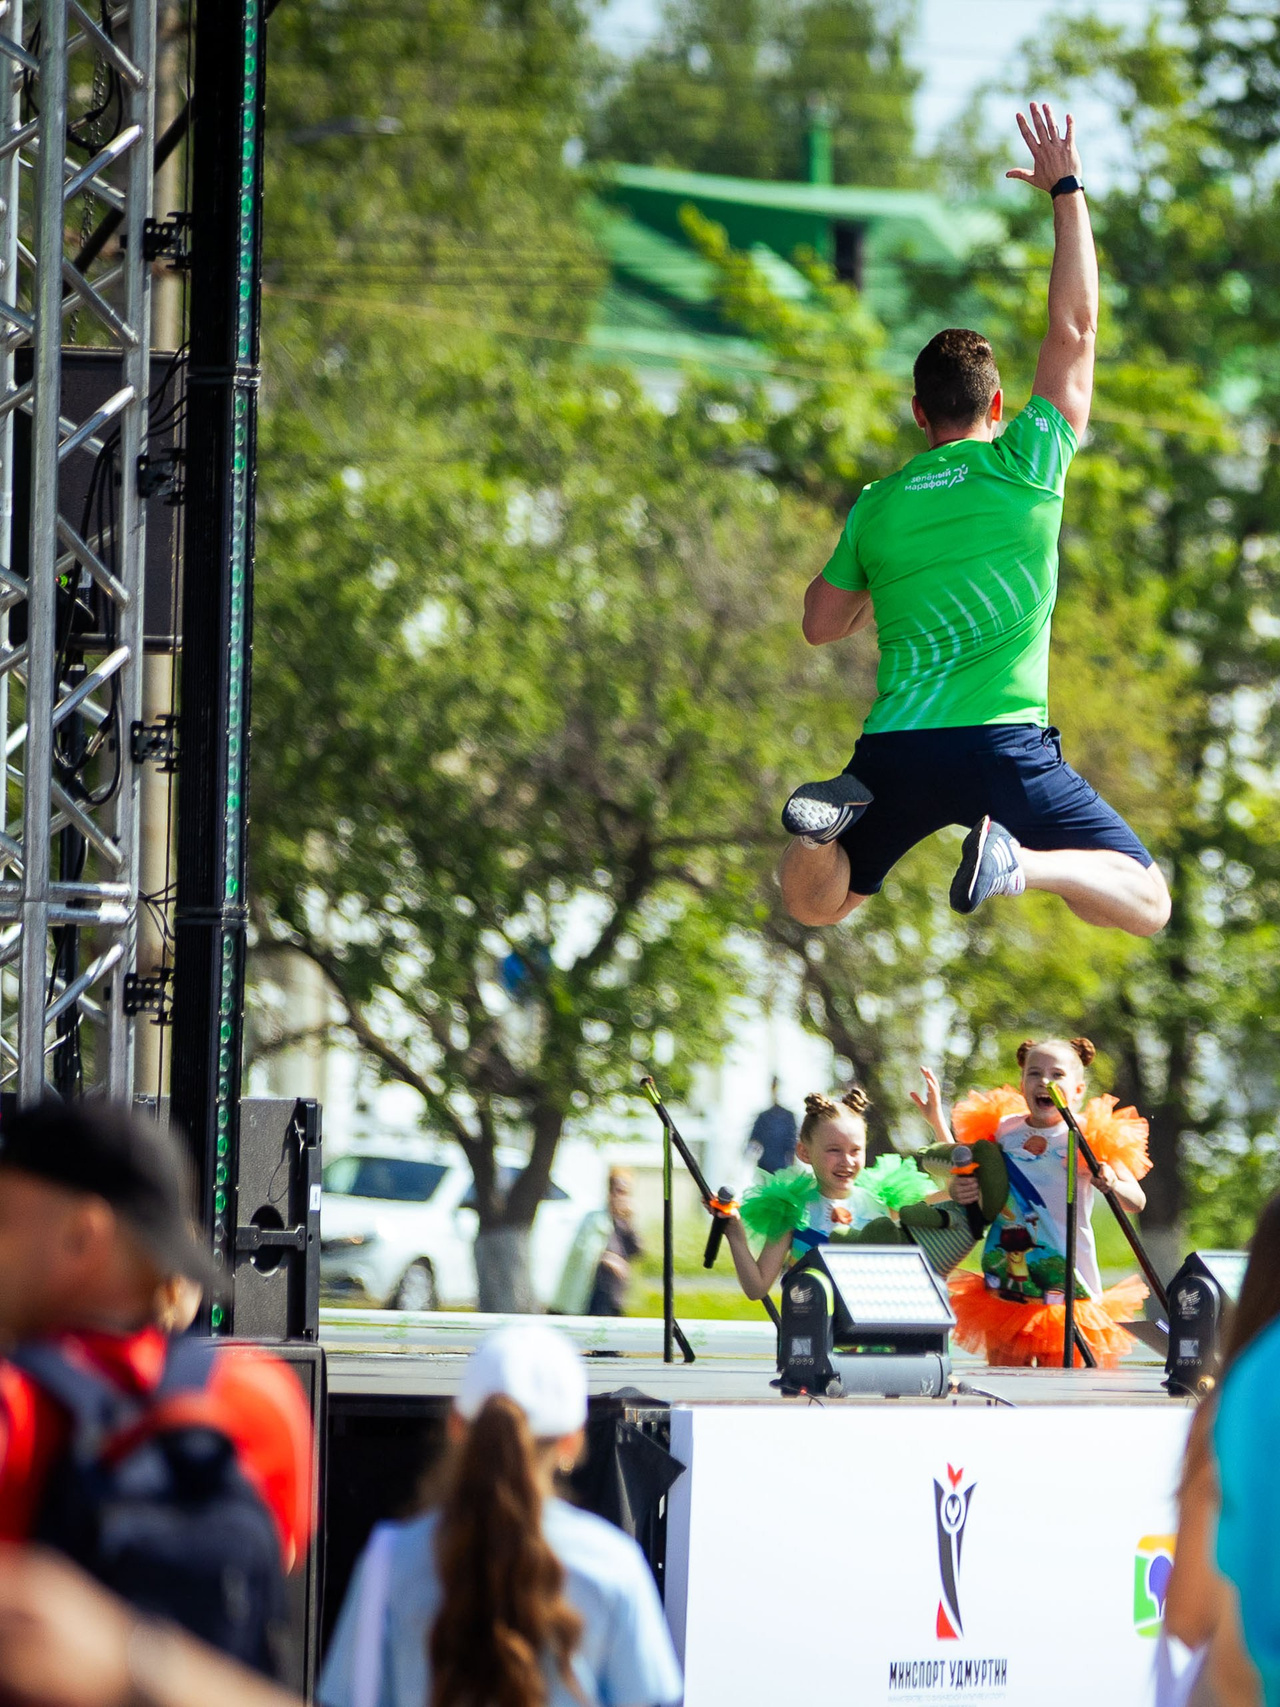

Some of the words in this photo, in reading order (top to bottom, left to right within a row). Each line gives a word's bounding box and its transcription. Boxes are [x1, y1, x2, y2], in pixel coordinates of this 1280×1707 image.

[911, 468, 951, 483] зелёный
[905, 479, 948, 491] марафон
[889, 1660, 946, 1690] МИНСПОРТ
[949, 1658, 1008, 1690] УДМУРТИИ
